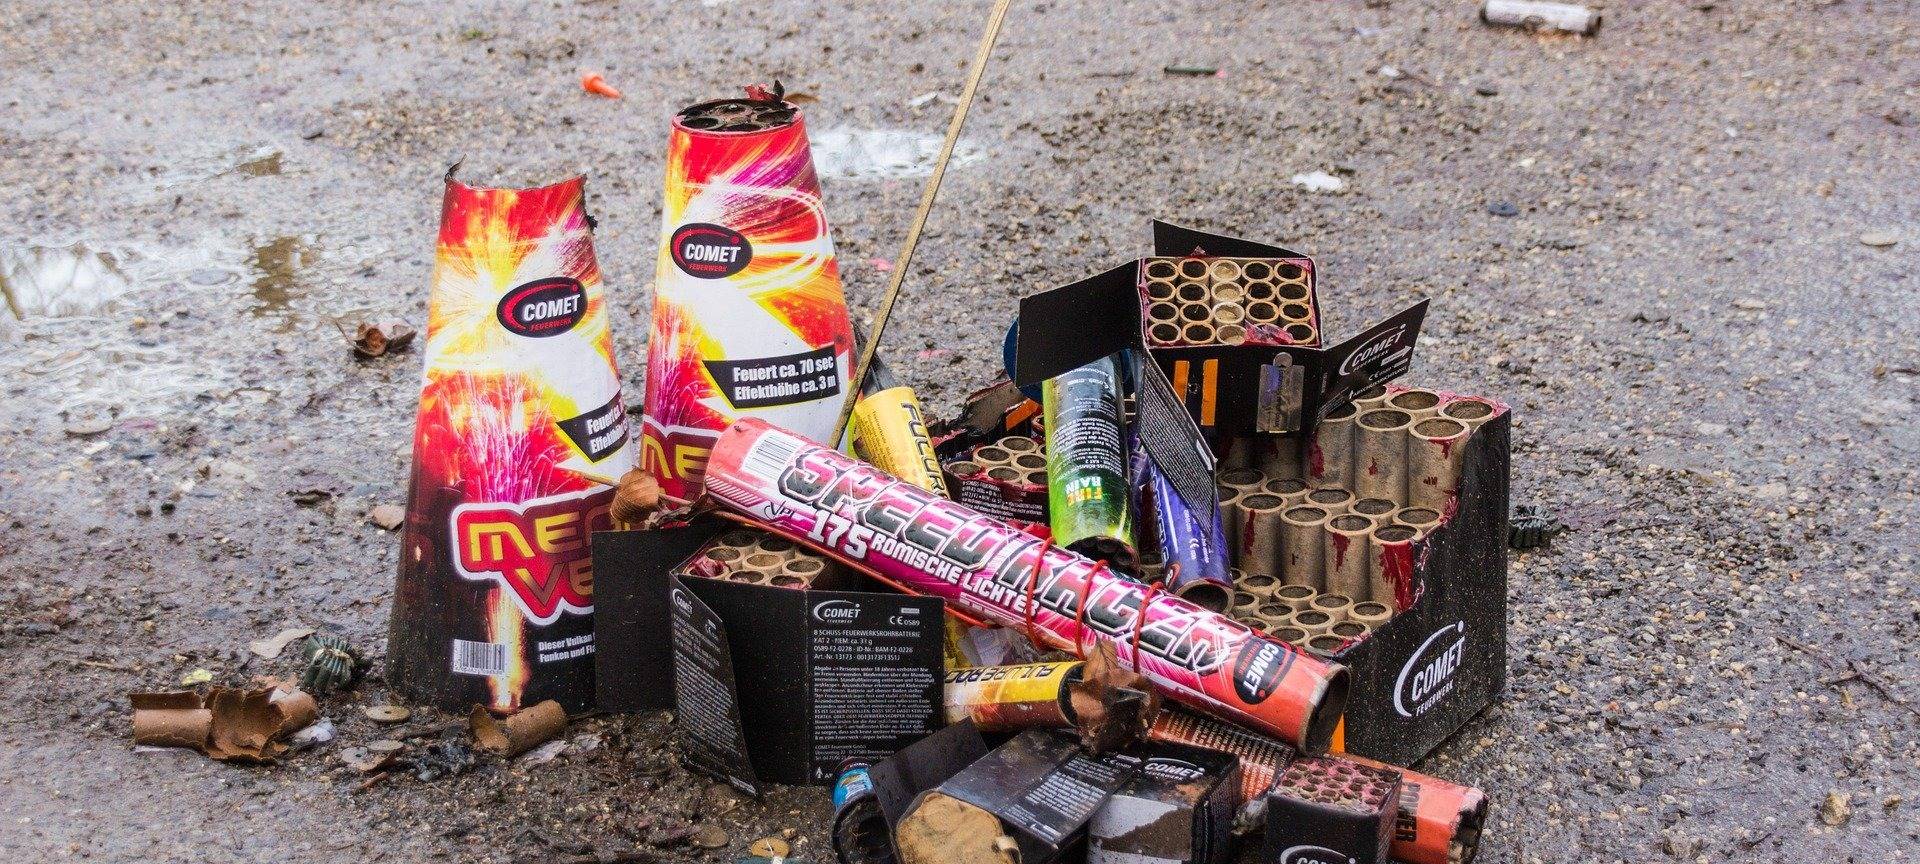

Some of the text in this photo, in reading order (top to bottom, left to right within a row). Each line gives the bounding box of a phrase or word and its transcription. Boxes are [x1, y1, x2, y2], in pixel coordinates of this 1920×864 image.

[684, 242, 742, 264] COMET
[523, 294, 582, 322] COMET
[1351, 328, 1406, 368] COMET
[733, 355, 835, 382] Feuert ca. 70 sec
[734, 374, 836, 400] Effekthöhe ca. 3 m
[643, 434, 712, 485] ME
[806, 509, 873, 561] 175
[777, 446, 1016, 574] SPEED
[994, 534, 1253, 675] RACER
[824, 607, 862, 619] COMET
[538, 638, 566, 652] Dieser
[570, 647, 585, 660] und
[1242, 640, 1281, 698] COMET
[1411, 635, 1466, 702] COMET
[1144, 761, 1205, 780] COMET
